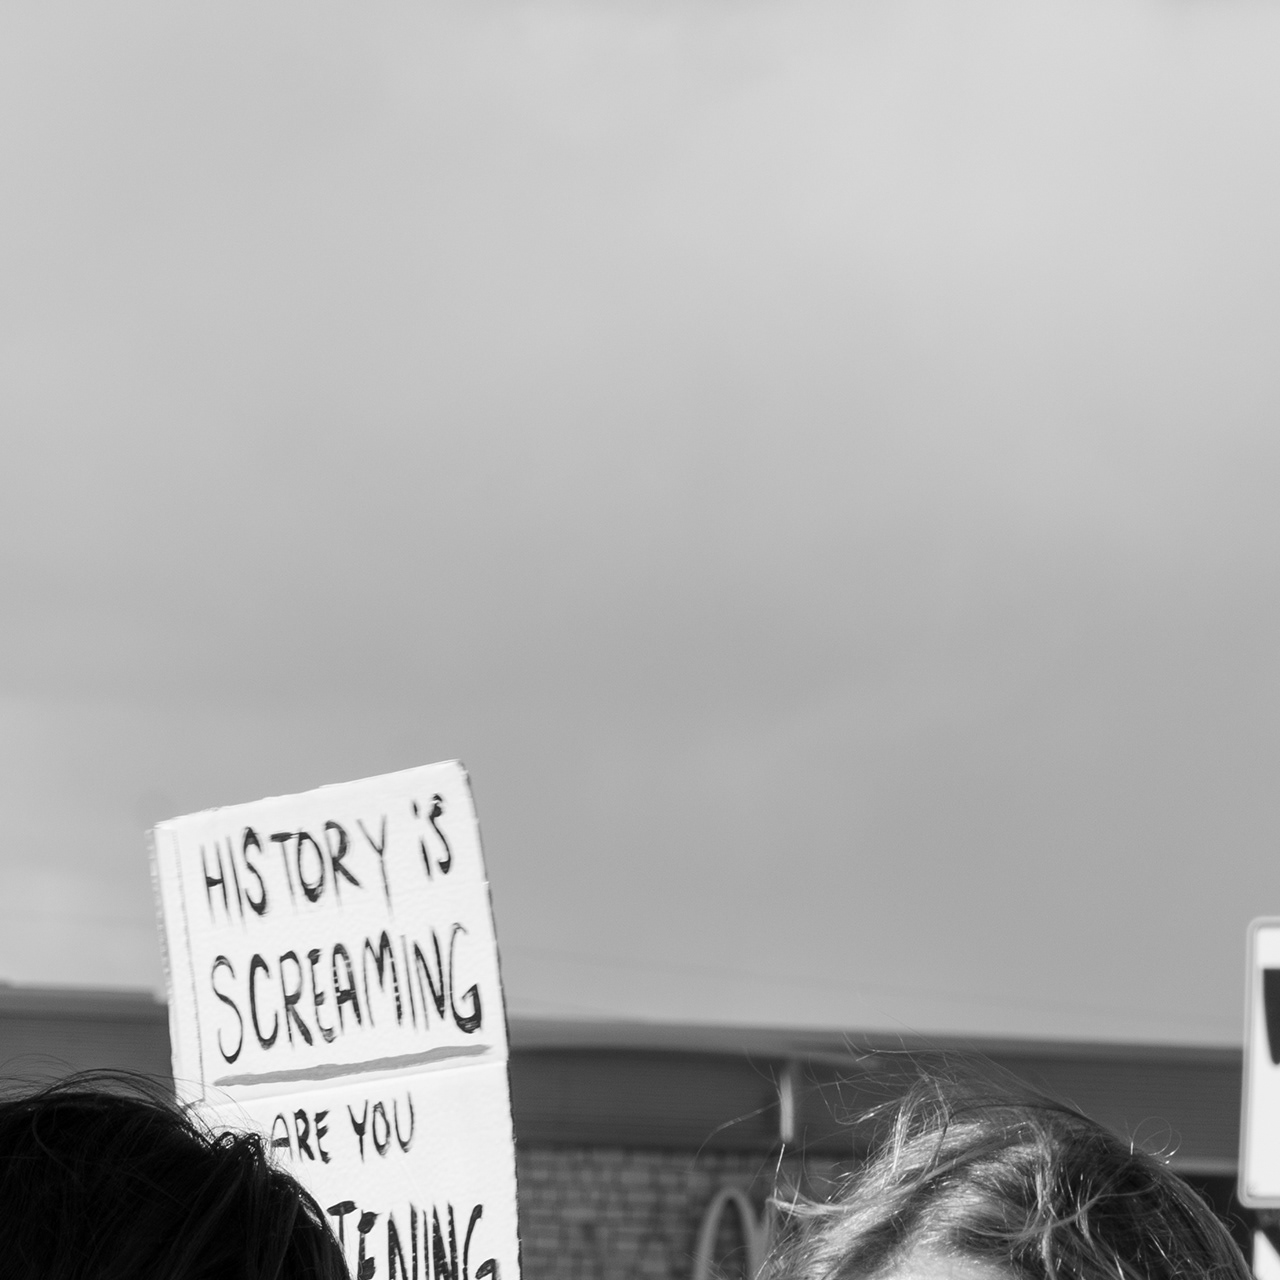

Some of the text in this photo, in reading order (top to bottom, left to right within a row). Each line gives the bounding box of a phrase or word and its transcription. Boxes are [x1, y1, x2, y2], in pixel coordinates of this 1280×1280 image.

[199, 812, 394, 931] HISTORY
[209, 921, 484, 1065] SCREAMING
[270, 1091, 416, 1165] ARE YOU
